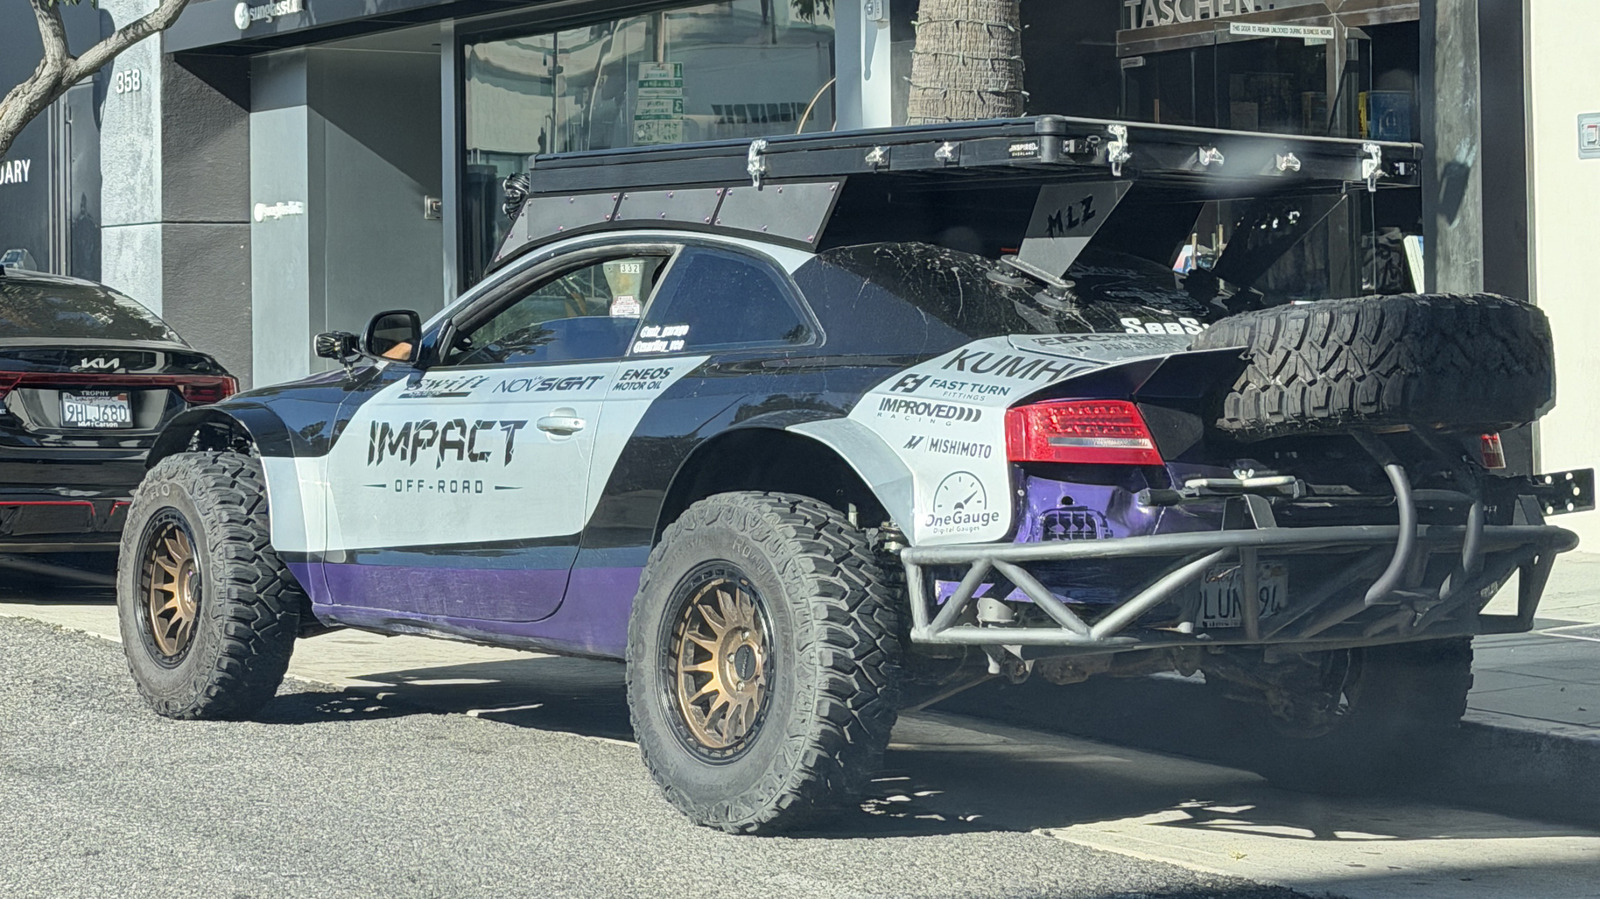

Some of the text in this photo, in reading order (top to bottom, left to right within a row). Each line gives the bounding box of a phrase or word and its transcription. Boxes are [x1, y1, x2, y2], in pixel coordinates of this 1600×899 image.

[1124, 0, 1255, 30] TASCHEN
[116, 69, 140, 94] 358
[1046, 194, 1096, 239] MLZ
[621, 263, 638, 273] 332
[1120, 317, 1210, 335] SaaS
[619, 367, 674, 381] ENEOS
[612, 381, 663, 391] MOTOR OIL
[929, 379, 1011, 397] FAST TURN
[942, 391, 985, 402] FITTINGS
[66, 404, 128, 421] 9HLJ680
[878, 397, 958, 419] IMPROVED
[877, 412, 952, 426] RACING
[367, 418, 528, 469] IMPACT
[929, 437, 992, 459] MISHIMOTO
[395, 479, 483, 494] OFF-ROAD
[925, 511, 1000, 527] OneGauge
